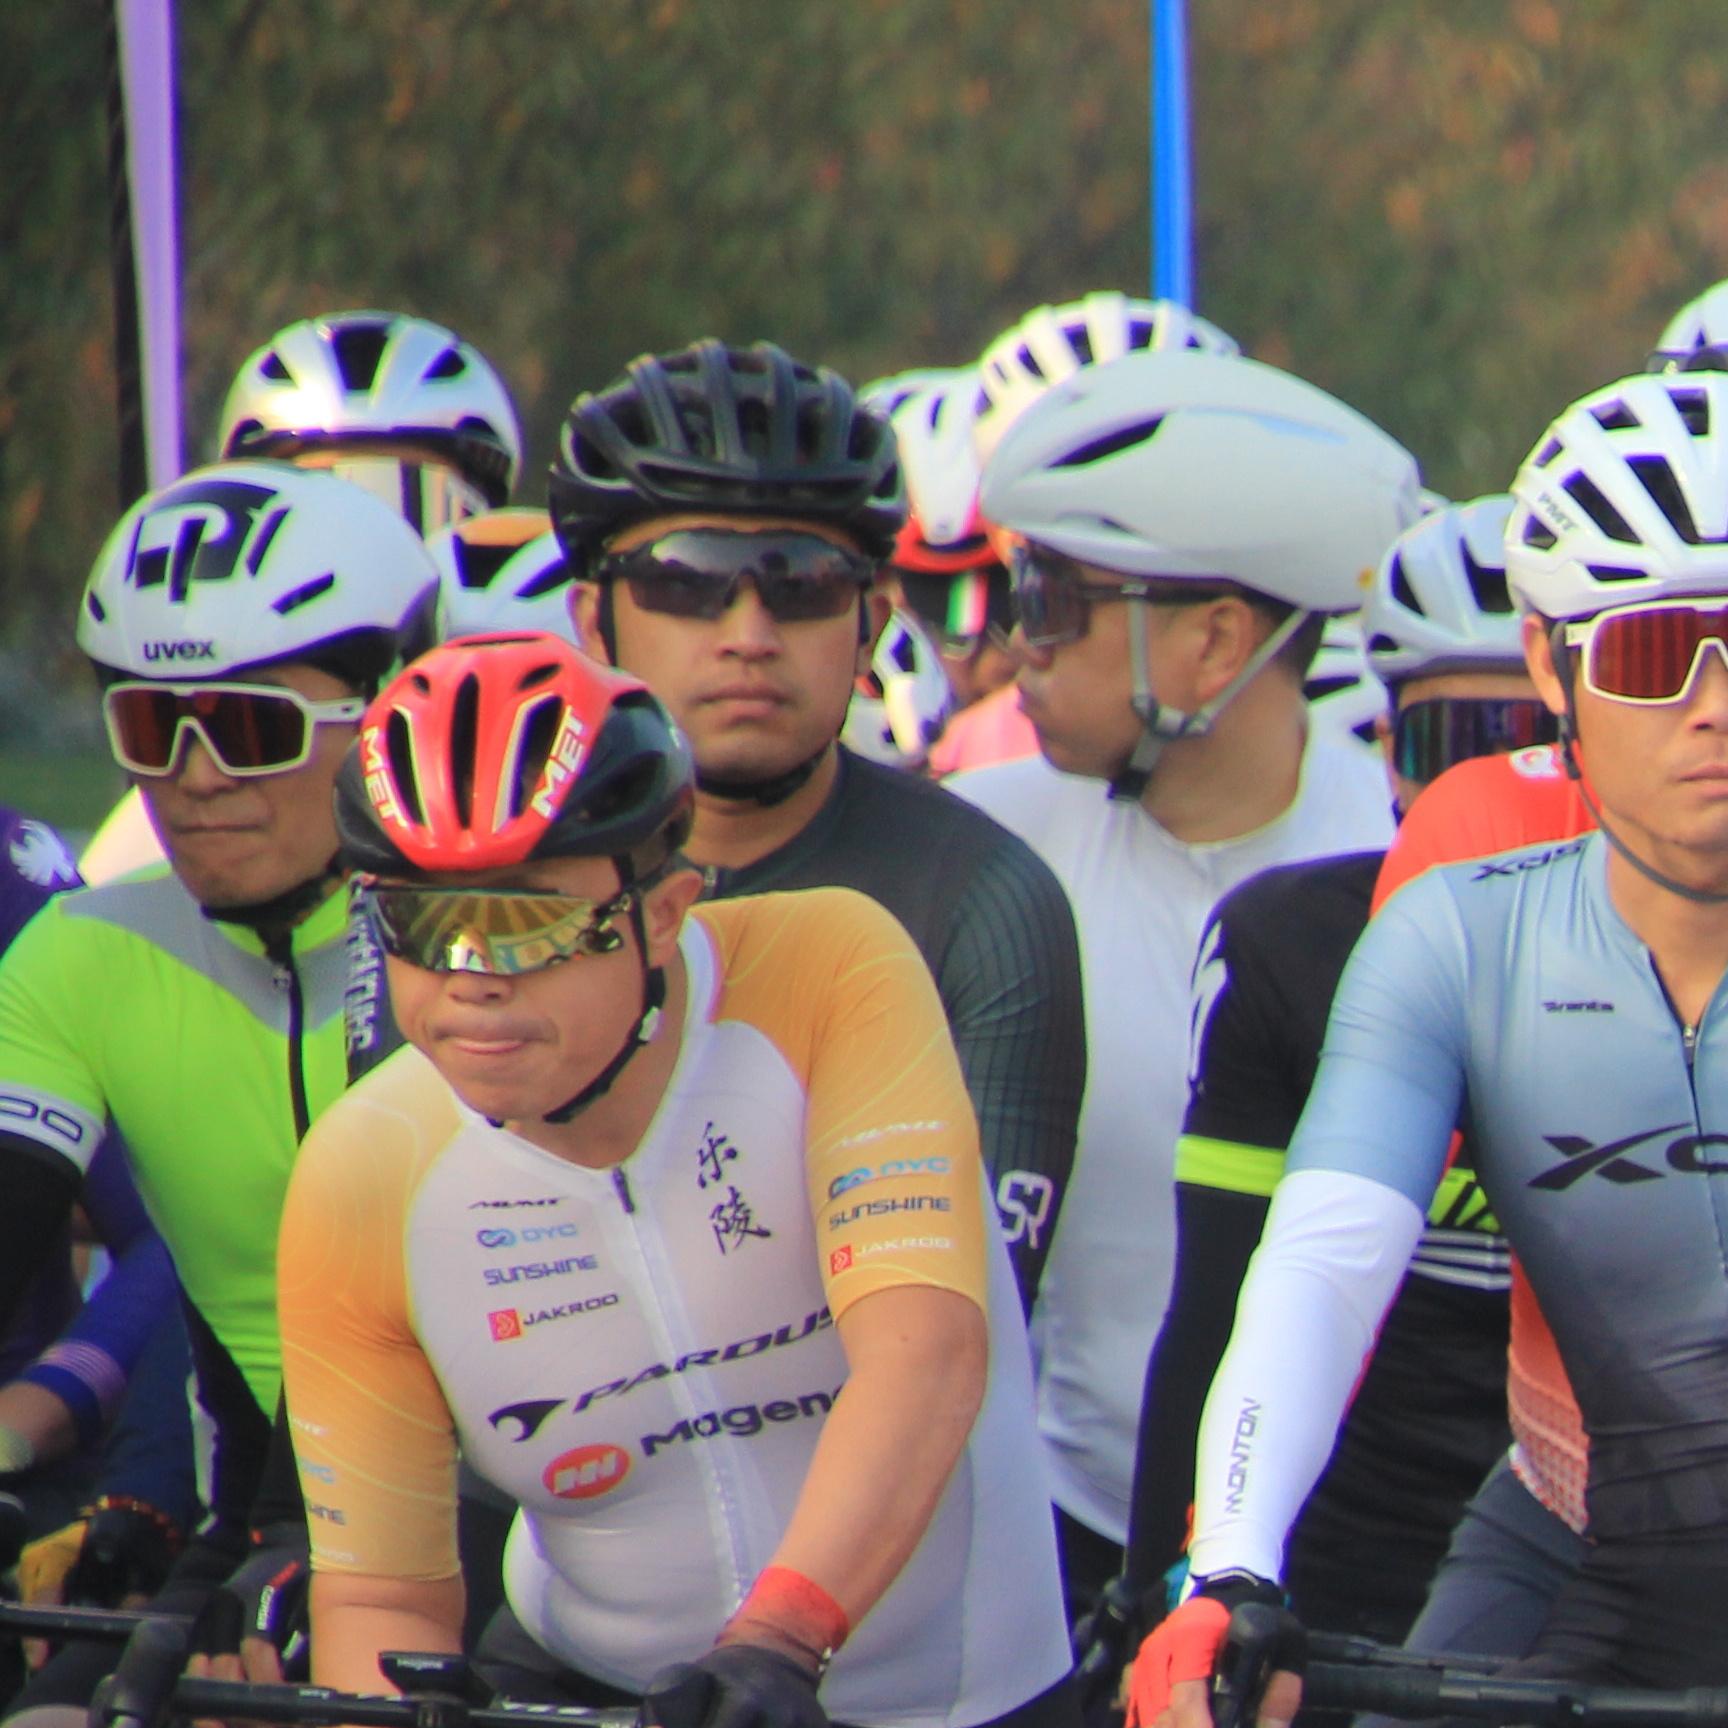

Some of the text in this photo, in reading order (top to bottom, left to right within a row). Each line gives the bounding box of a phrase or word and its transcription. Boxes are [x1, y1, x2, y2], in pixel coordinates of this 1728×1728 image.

[142, 641, 216, 662] uvex
[361, 728, 404, 830] MET
[532, 712, 584, 818] MET
[828, 1196, 952, 1234] SUNSHINE
[856, 1236, 955, 1260] JAKROO
[483, 1253, 598, 1288] SUNSHINE
[522, 1293, 618, 1327] JAKROO
[573, 1304, 836, 1414] PARDUS
[1223, 1397, 1262, 1514] MONTON
